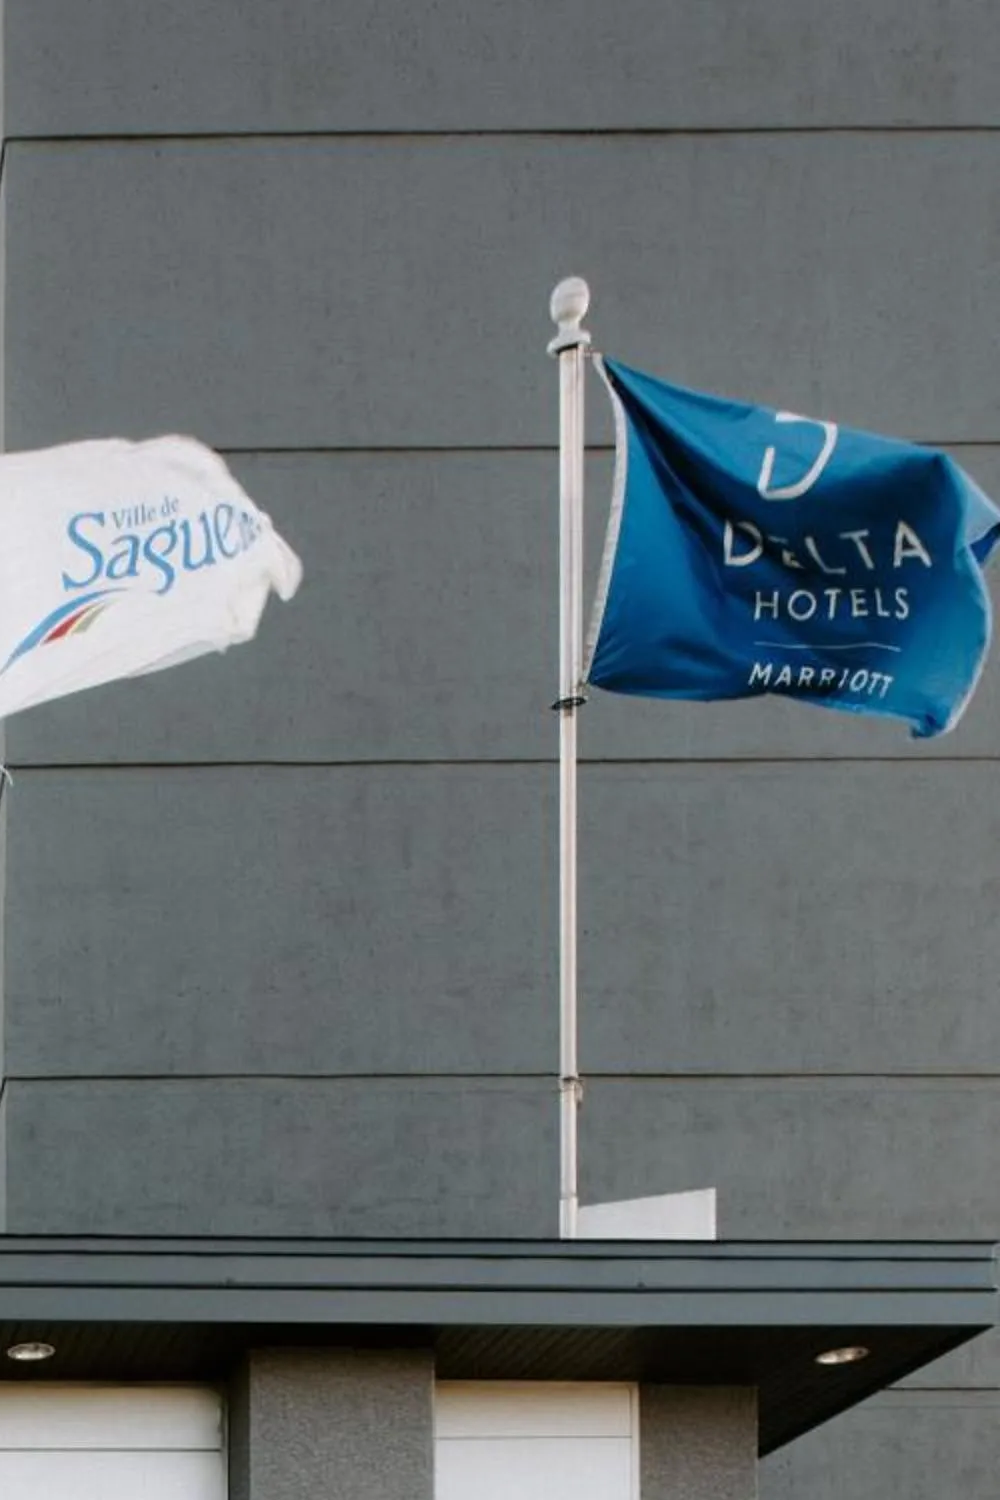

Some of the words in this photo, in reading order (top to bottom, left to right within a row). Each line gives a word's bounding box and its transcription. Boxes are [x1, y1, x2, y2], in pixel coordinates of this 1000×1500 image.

[112, 502, 156, 529] Ville
[161, 496, 179, 516] de
[754, 588, 910, 621] HOTELS
[748, 661, 894, 698] MARRIOTT
